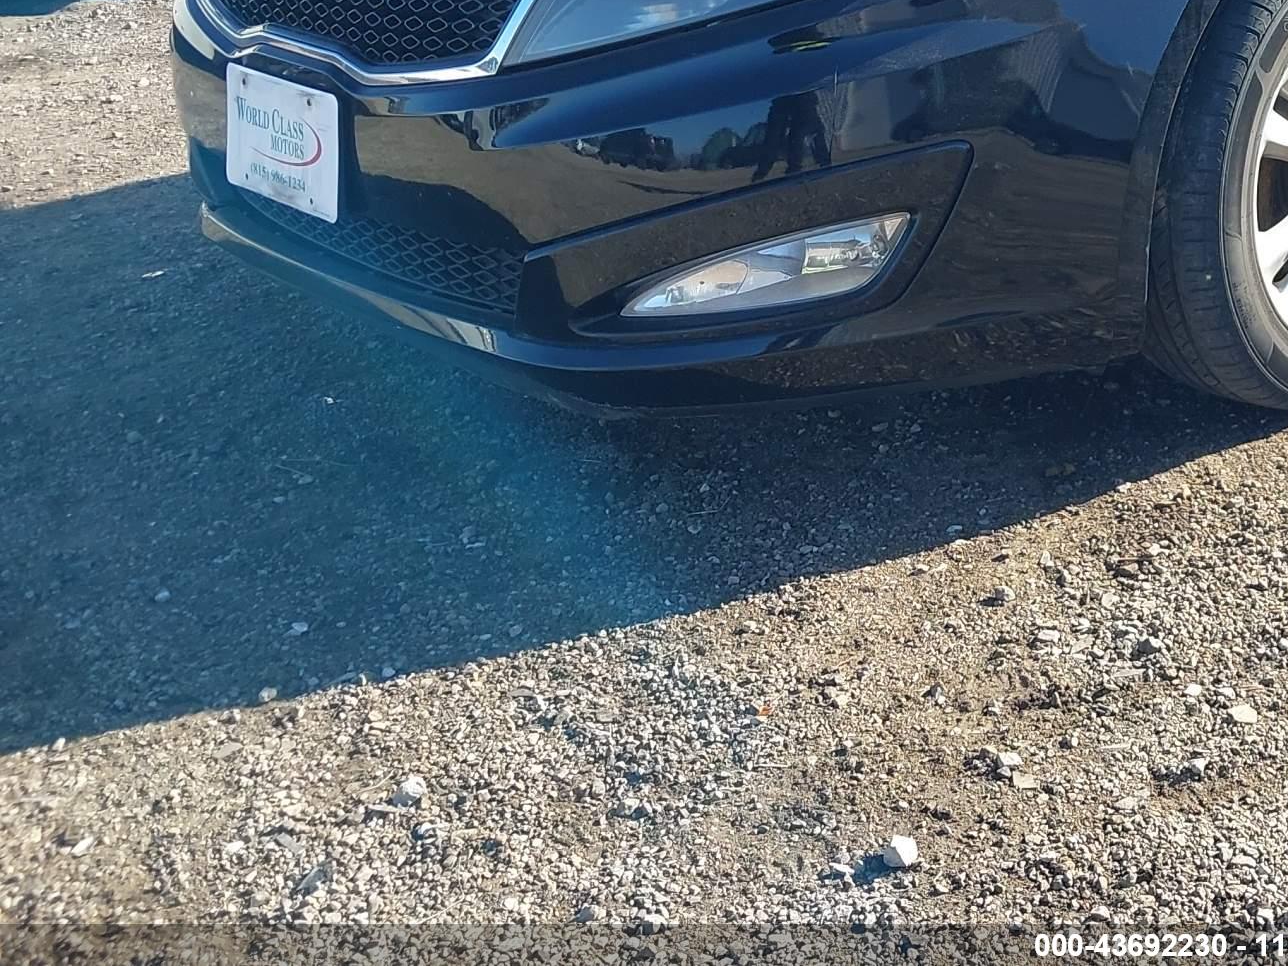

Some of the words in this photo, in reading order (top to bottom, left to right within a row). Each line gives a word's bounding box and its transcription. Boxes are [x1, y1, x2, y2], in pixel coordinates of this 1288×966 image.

[235, 96, 269, 130] WORLD
[272, 108, 304, 142] CLASS
[270, 134, 304, 160] MOTORS
[250, 162, 270, 180] (815)
[271, 171, 306, 192] 986-1234
